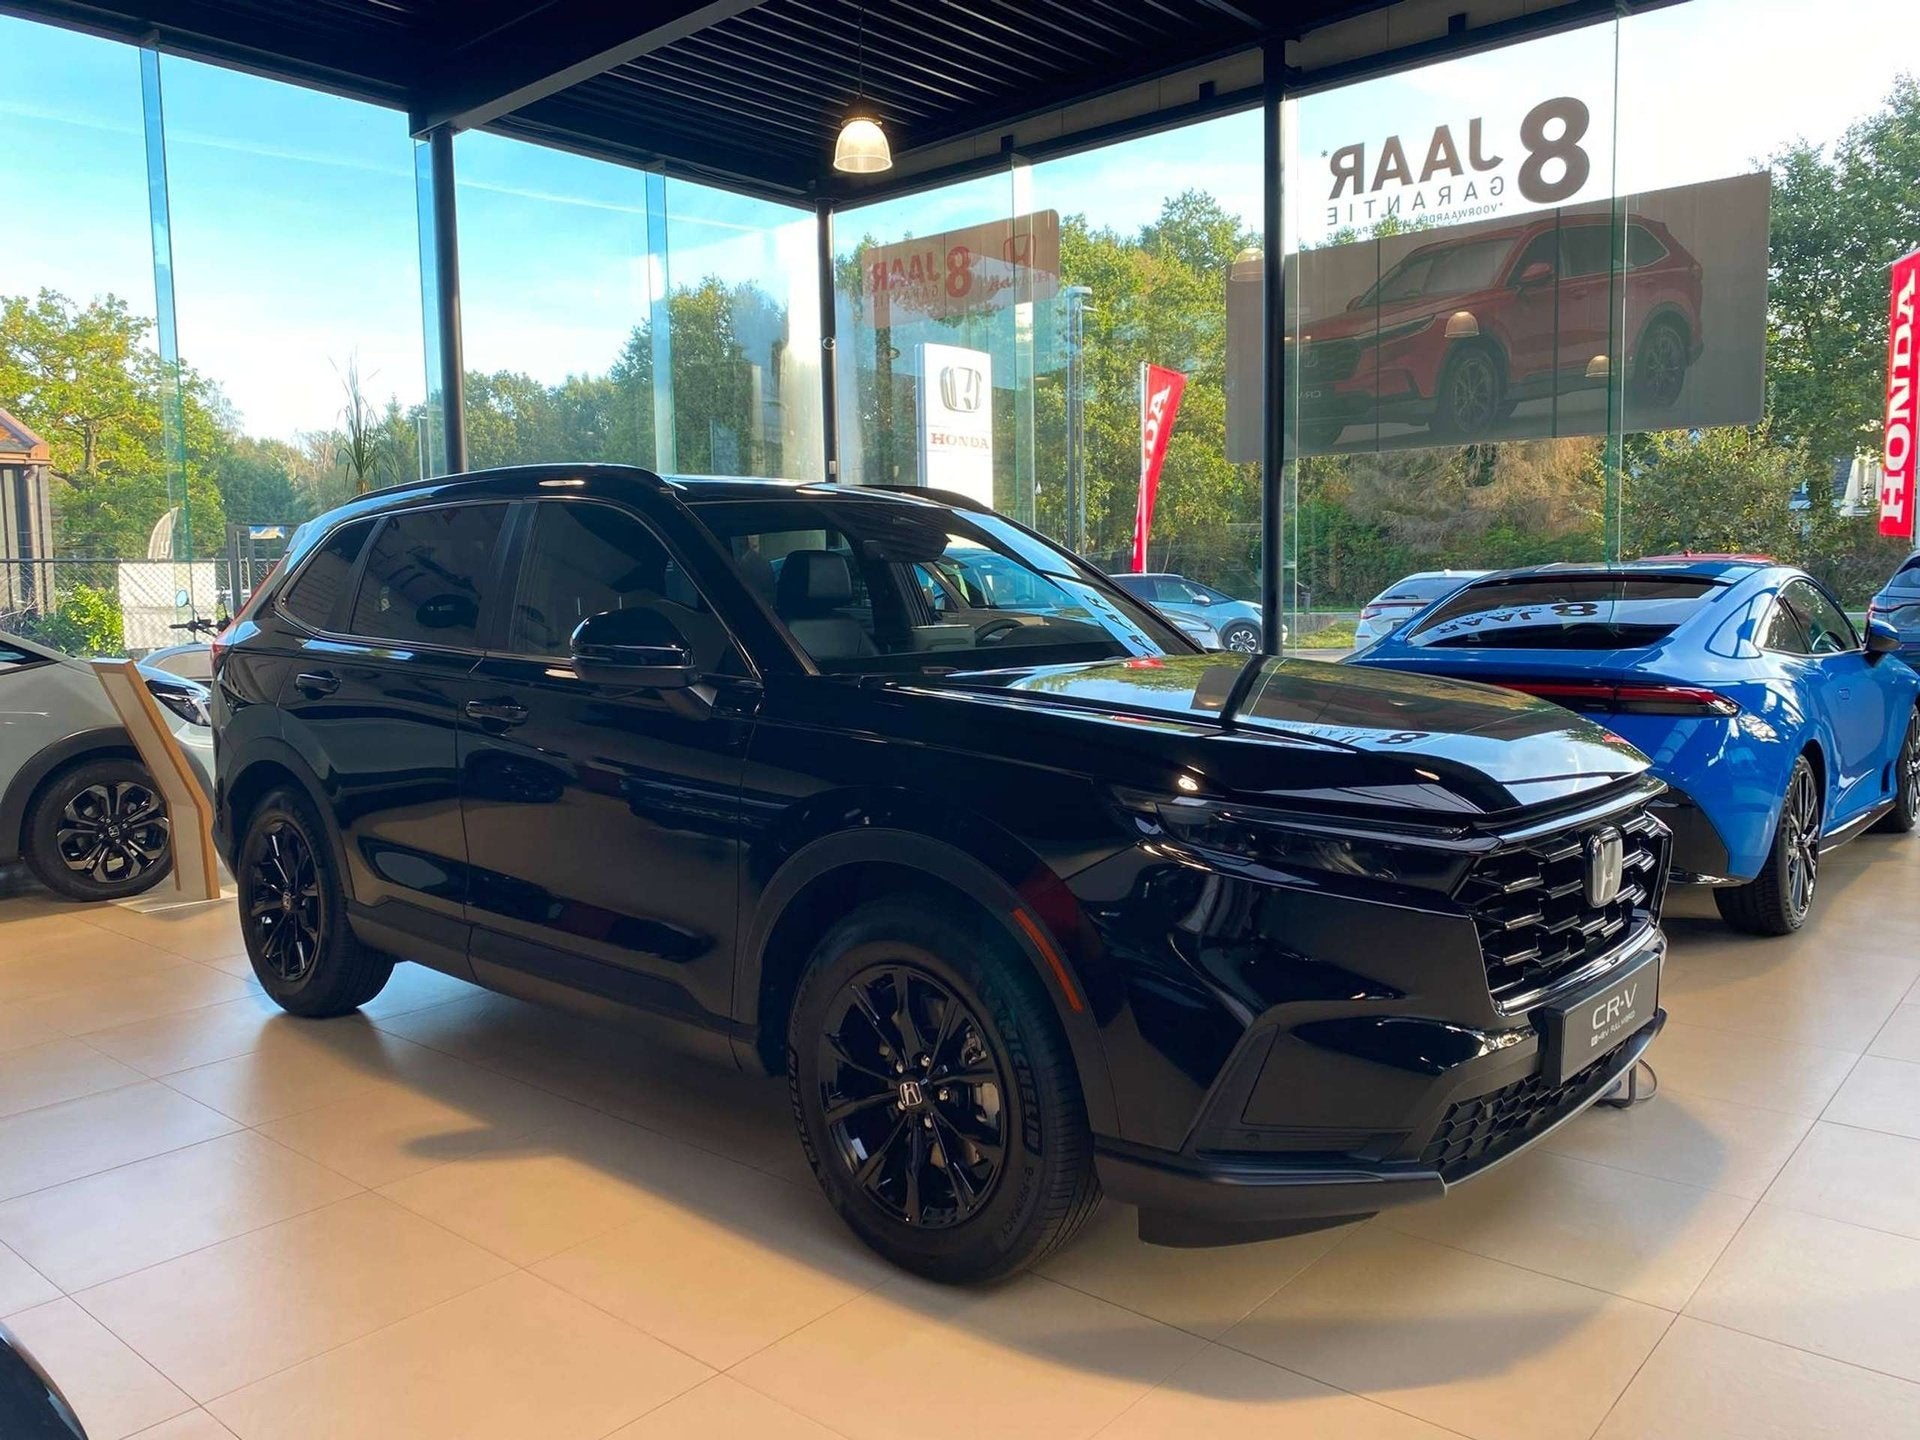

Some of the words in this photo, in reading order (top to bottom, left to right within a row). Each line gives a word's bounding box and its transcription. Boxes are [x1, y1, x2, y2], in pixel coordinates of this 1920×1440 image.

[1879, 269, 1916, 523] HONDA
[931, 432, 990, 450] HONDA
[1592, 982, 1637, 1030] CR-V
